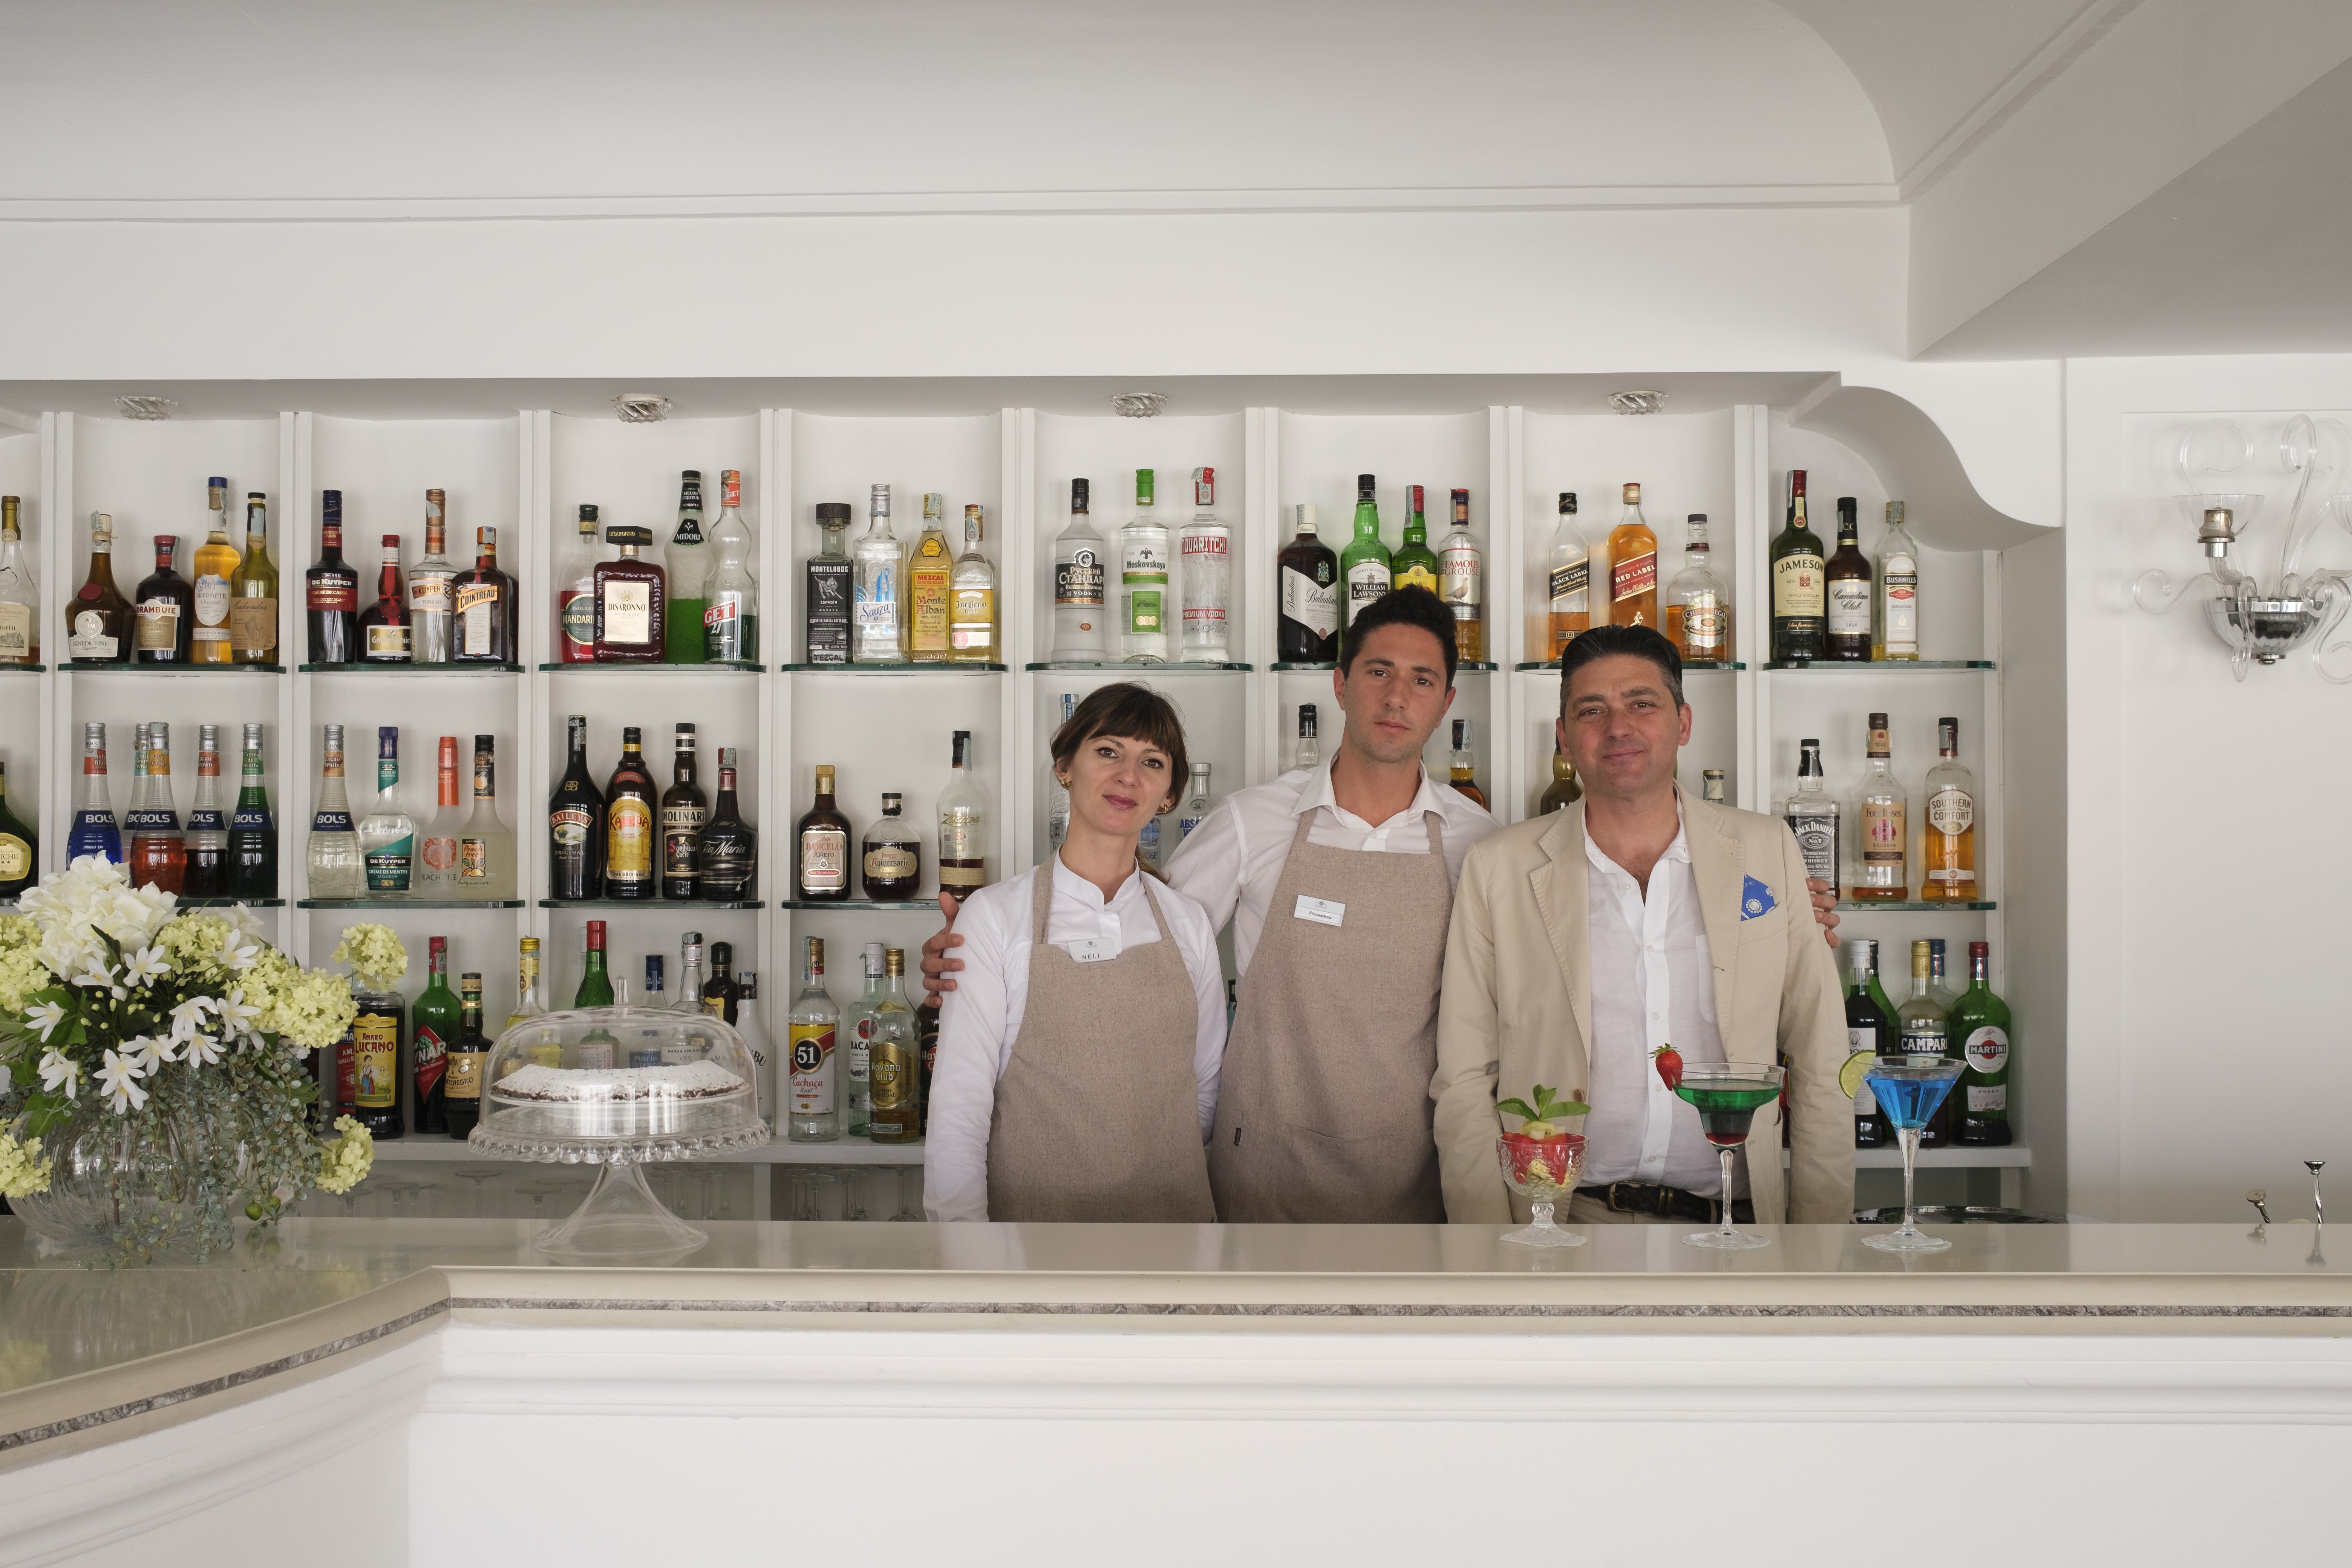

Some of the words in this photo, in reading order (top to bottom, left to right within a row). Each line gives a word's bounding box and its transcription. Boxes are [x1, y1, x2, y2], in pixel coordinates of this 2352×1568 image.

[676, 533, 701, 541] MIDORI
[1181, 537, 1227, 554] TOVARITCH!
[1126, 560, 1165, 570] Moskovskaya
[1445, 560, 1479, 569] FAMOUS
[1780, 559, 1824, 573] JAMESON
[1444, 568, 1479, 576] GROUSE
[1615, 574, 1631, 583] RED
[1632, 565, 1655, 577] LABEL
[1617, 566, 1635, 575] JOHNNIE
[1551, 577, 1570, 586] BLACK
[1570, 570, 1588, 579] LABEL
[418, 585, 441, 595] KUYPER
[1286, 575, 1295, 612] Ballantine's
[1832, 589, 1868, 600] Canadian
[460, 590, 495, 608] COINTREAU
[916, 596, 946, 605] Monte
[1305, 587, 1338, 606] Ballantine's
[136, 605, 176, 614] DRAMBUIE
[234, 600, 268, 611] Calvados
[608, 603, 646, 612] DISARONNO
[916, 605, 945, 614] Alban
[1841, 600, 1861, 610] Club
[705, 603, 733, 624] GET
[860, 603, 891, 623] Sauza
[1711, 609, 1726, 619] REGAL
[711, 621, 723, 634] 27
[1931, 799, 1971, 809] SOUTHERN
[663, 810, 704, 822] MOLINARI
[1866, 808, 1882, 817] Four
[1883, 808, 1902, 817] Roses
[1934, 811, 1970, 821] COMFORT
[85, 814, 115, 823] BOLS
[140, 814, 170, 822] BOLS
[234, 814, 263, 823] BOLS
[317, 815, 346, 824] BOLS
[551, 812, 590, 825] BAILEYS
[609, 812, 650, 832] KAHLÚA
[942, 813, 980, 827] Zacapa
[1794, 824, 1811, 836] JACK
[1811, 821, 1836, 836] DANIEL'S
[668, 839, 696, 854] Sambuca
[701, 840, 720, 854] Tia
[710, 841, 746, 856] Maria
[806, 842, 842, 851] BARCELÓ
[869, 858, 910, 868] Aniversario
[458, 877, 491, 887] Liqueur
[1308, 911, 1332, 920] Pierandrea
[362, 1032, 383, 1041] AMARO
[355, 1037, 394, 1054] LUCANO
[850, 1040, 869, 1050] BACA
[1901, 1037, 1947, 1051] CAMPARI
[797, 1046, 816, 1063] 51
[1970, 1045, 2006, 1054] MARTINI
[871, 1061, 901, 1072] Havana
[446, 1077, 474, 1086] NTENEGRO
[876, 1072, 894, 1081] Club
[793, 1076, 823, 1090] Cachaça
